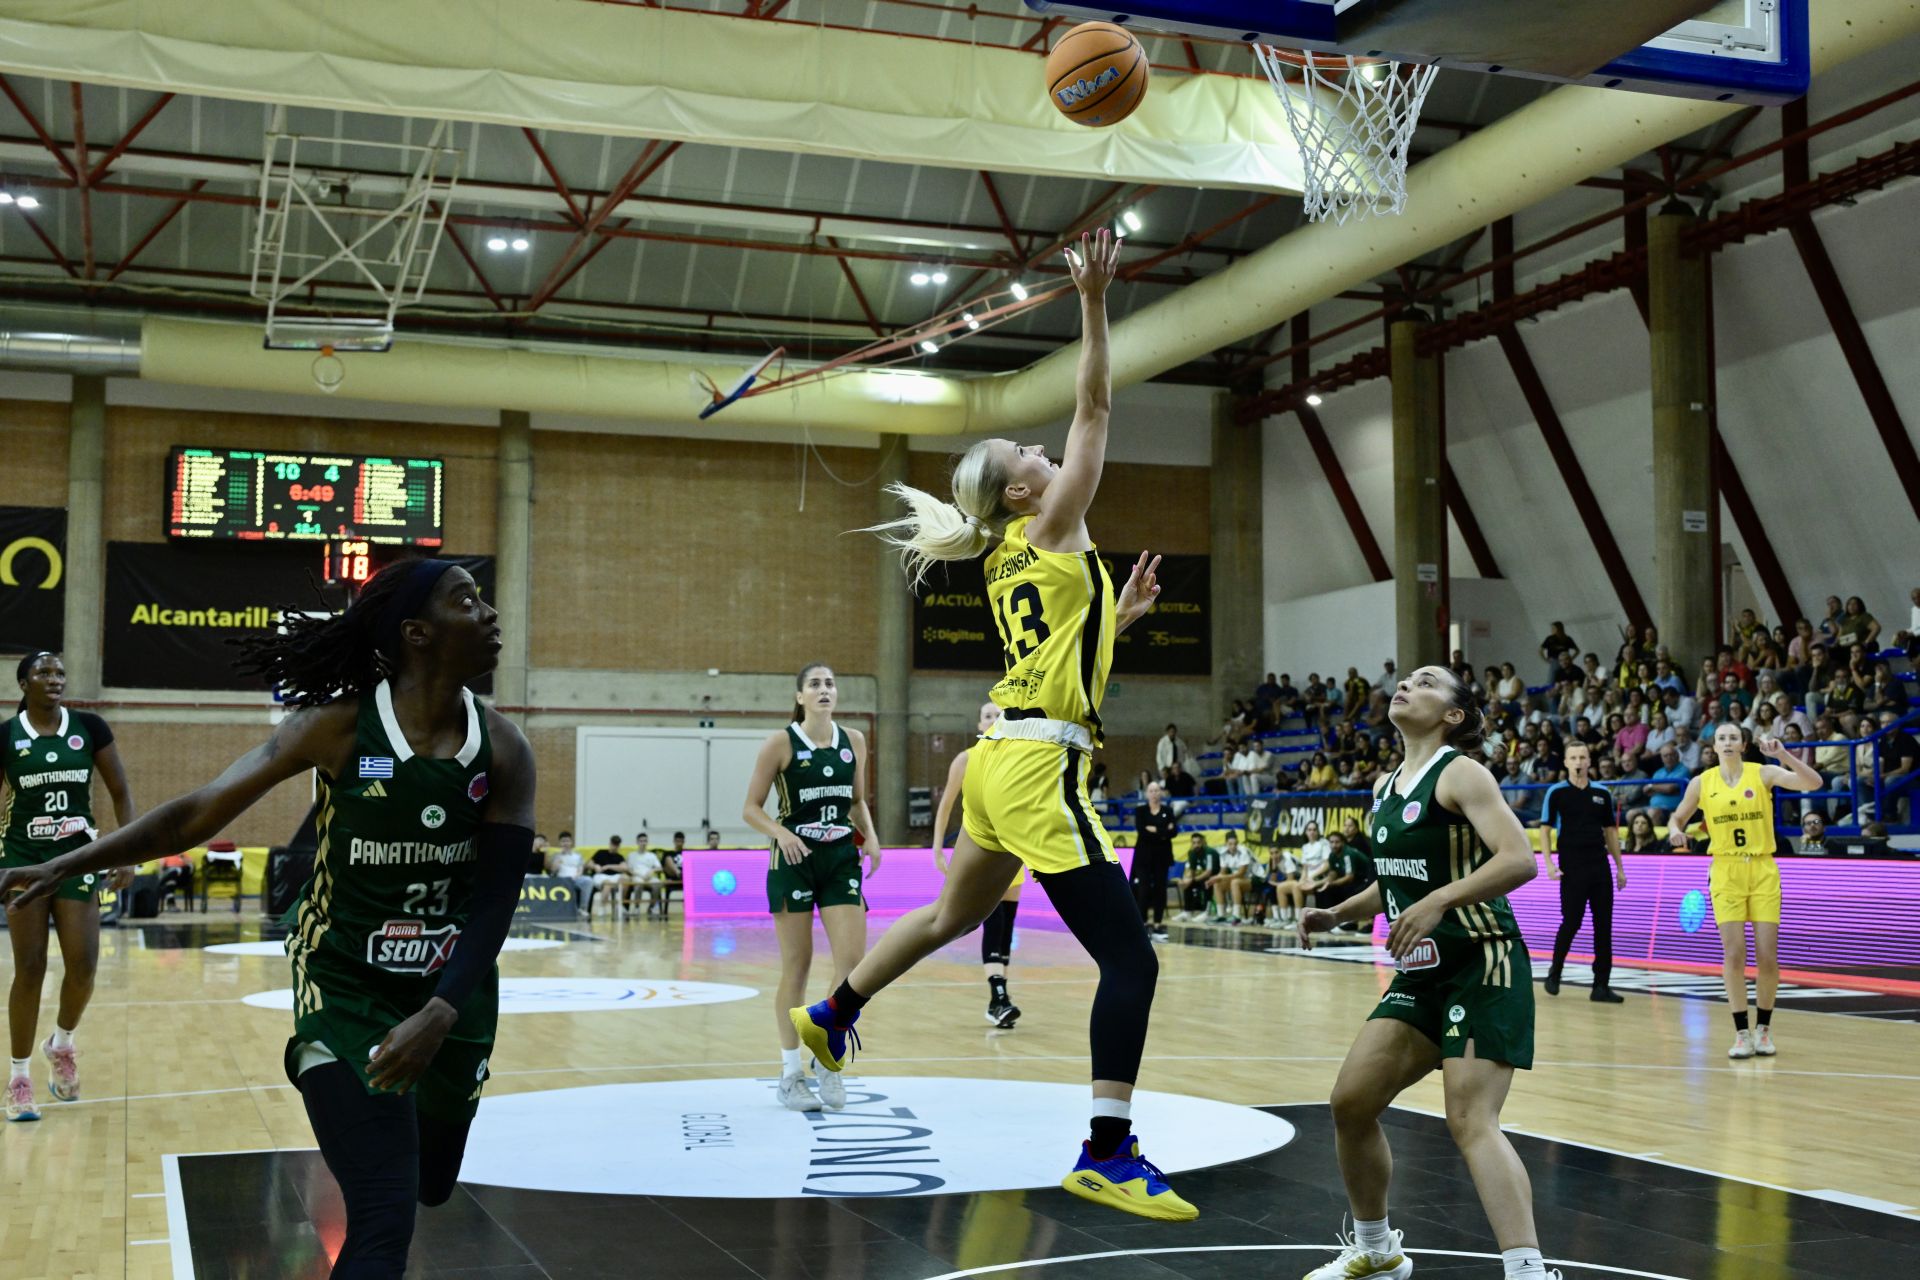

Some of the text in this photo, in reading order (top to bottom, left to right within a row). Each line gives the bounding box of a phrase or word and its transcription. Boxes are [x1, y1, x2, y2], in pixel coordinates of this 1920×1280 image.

[1056, 66, 1120, 106] Wilson
[274, 462, 301, 480] 10
[324, 465, 340, 482] 4
[342, 555, 369, 580] 18
[996, 581, 1051, 672] 13
[44, 790, 69, 813] 20
[820, 804, 838, 822] 18
[1733, 828, 1746, 847] 6
[403, 877, 452, 916] 23
